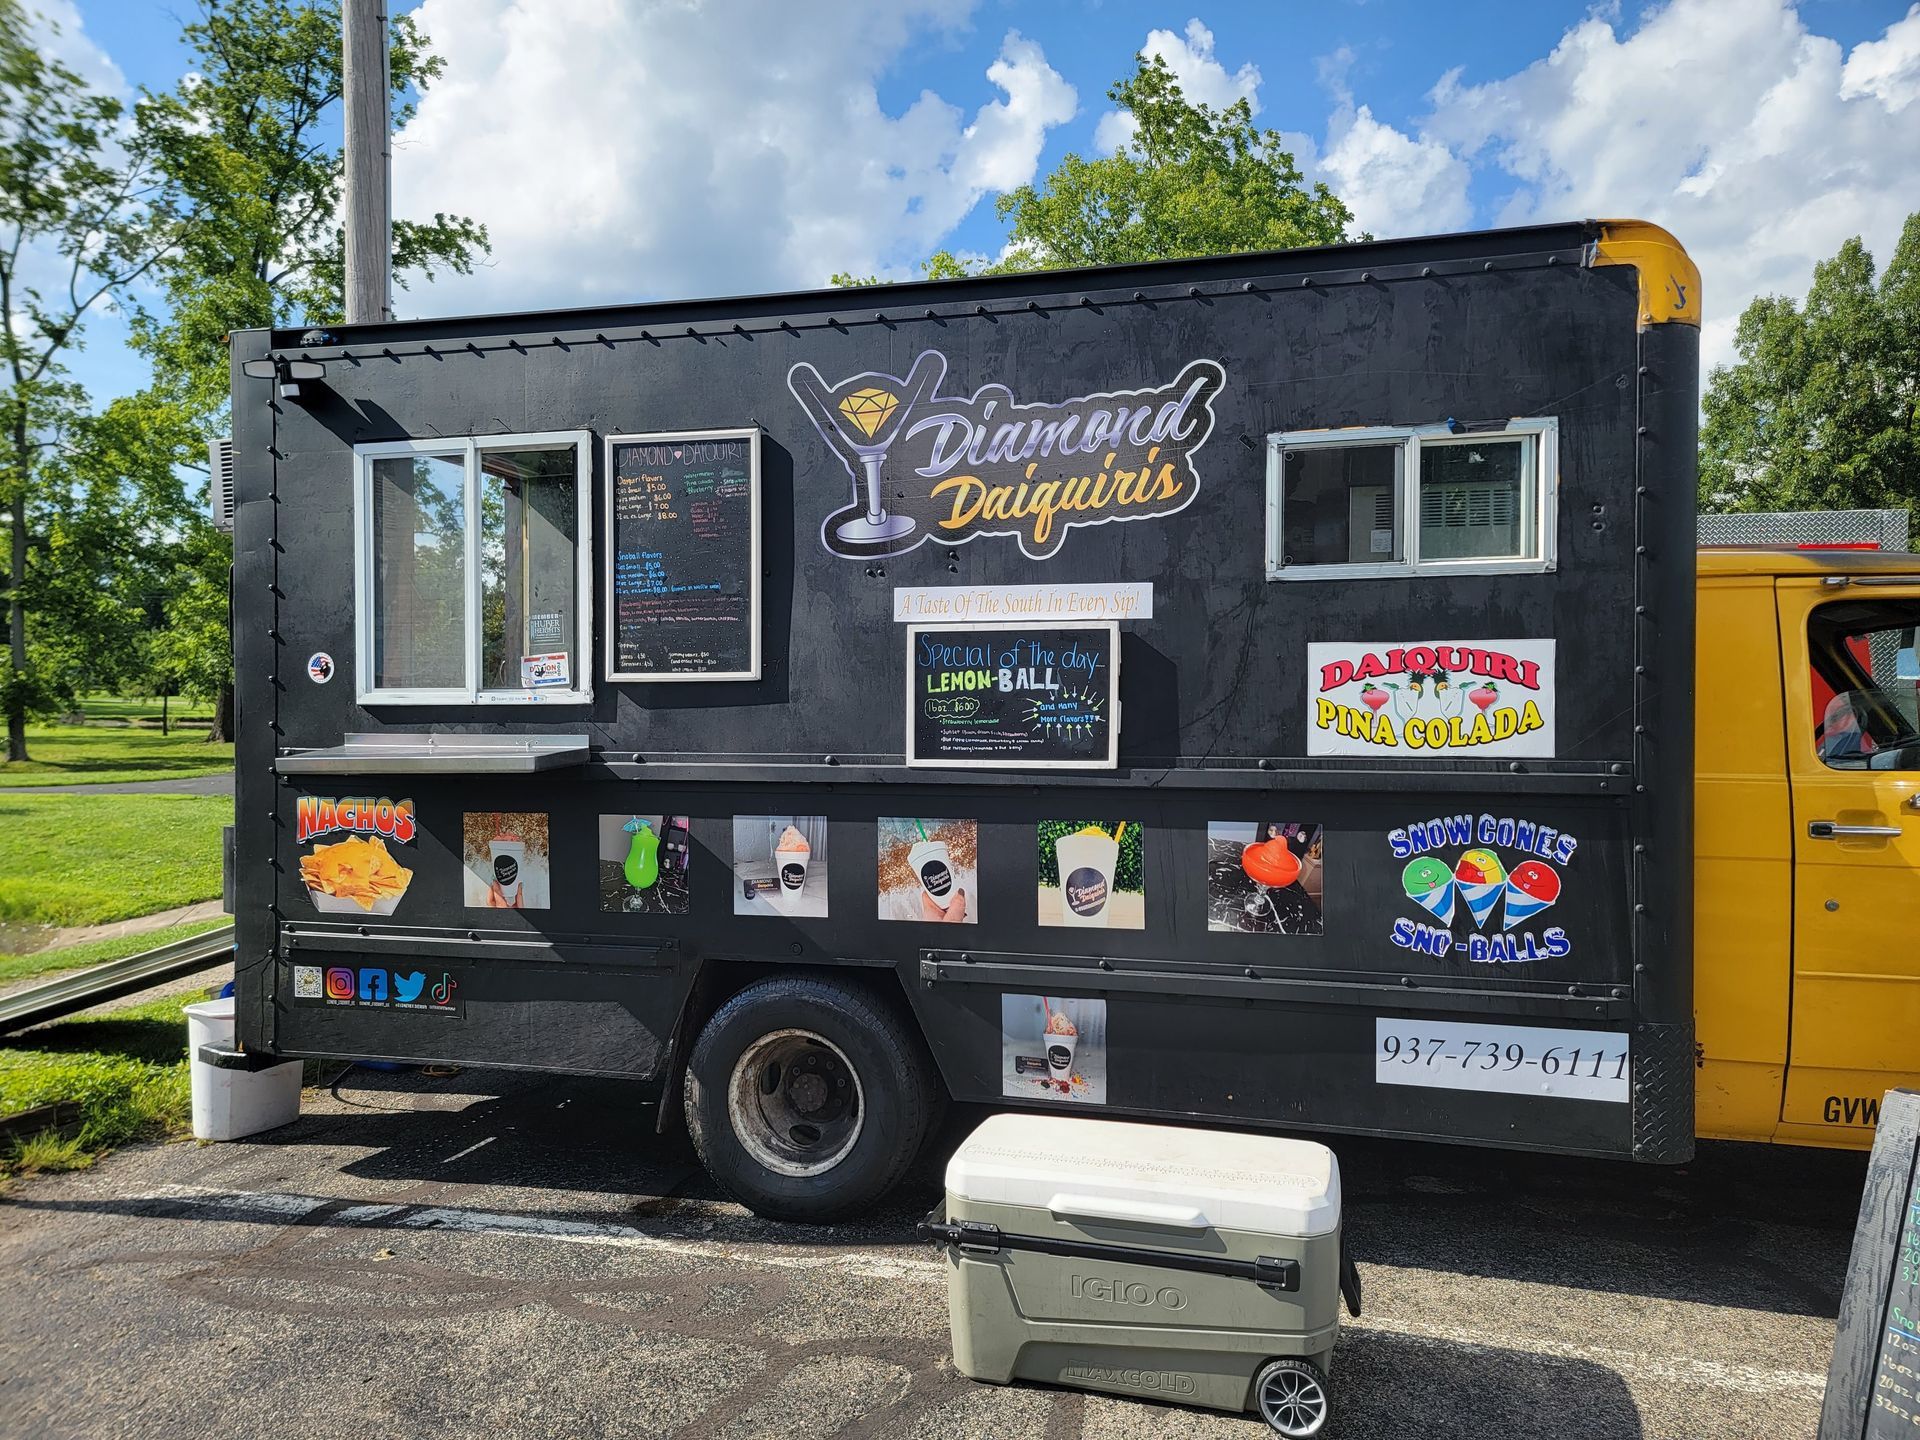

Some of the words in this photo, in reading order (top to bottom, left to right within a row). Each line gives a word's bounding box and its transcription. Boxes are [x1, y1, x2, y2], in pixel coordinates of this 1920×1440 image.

[906, 376, 1208, 477] Diamond
[616, 445, 674, 467] DIAMOND
[930, 447, 1182, 543] Daiquiris
[898, 594, 911, 617] A
[915, 592, 949, 614] Taste
[954, 590, 975, 621] Of
[976, 590, 1000, 613] The
[1002, 589, 1042, 615] South
[1046, 591, 1063, 614] In
[1067, 592, 1108, 620] Every
[1110, 590, 1140, 617] Sip!
[534, 620, 560, 629] HUBER
[918, 633, 991, 669] Special
[999, 638, 1026, 669] of
[1028, 641, 1056, 666] the
[1320, 645, 1541, 692] DAIQUIRI
[927, 667, 1060, 694] LEMON-BALL
[942, 717, 973, 726] Strawberry
[1040, 703, 1056, 711] and
[1315, 697, 1398, 746] PINA
[1403, 699, 1545, 750] COLADA
[296, 796, 417, 845] NACHOS
[1387, 813, 1473, 859] SNOW
[1477, 813, 1578, 866] CONES
[1380, 1034, 1629, 1080] 937-739-6111
[1071, 1274, 1188, 1311] IGLOO
[1887, 1332, 1918, 1355] 12oz
[1066, 1359, 1197, 1396] MAXCOLD
[1883, 1353, 1913, 1379] 16oz
